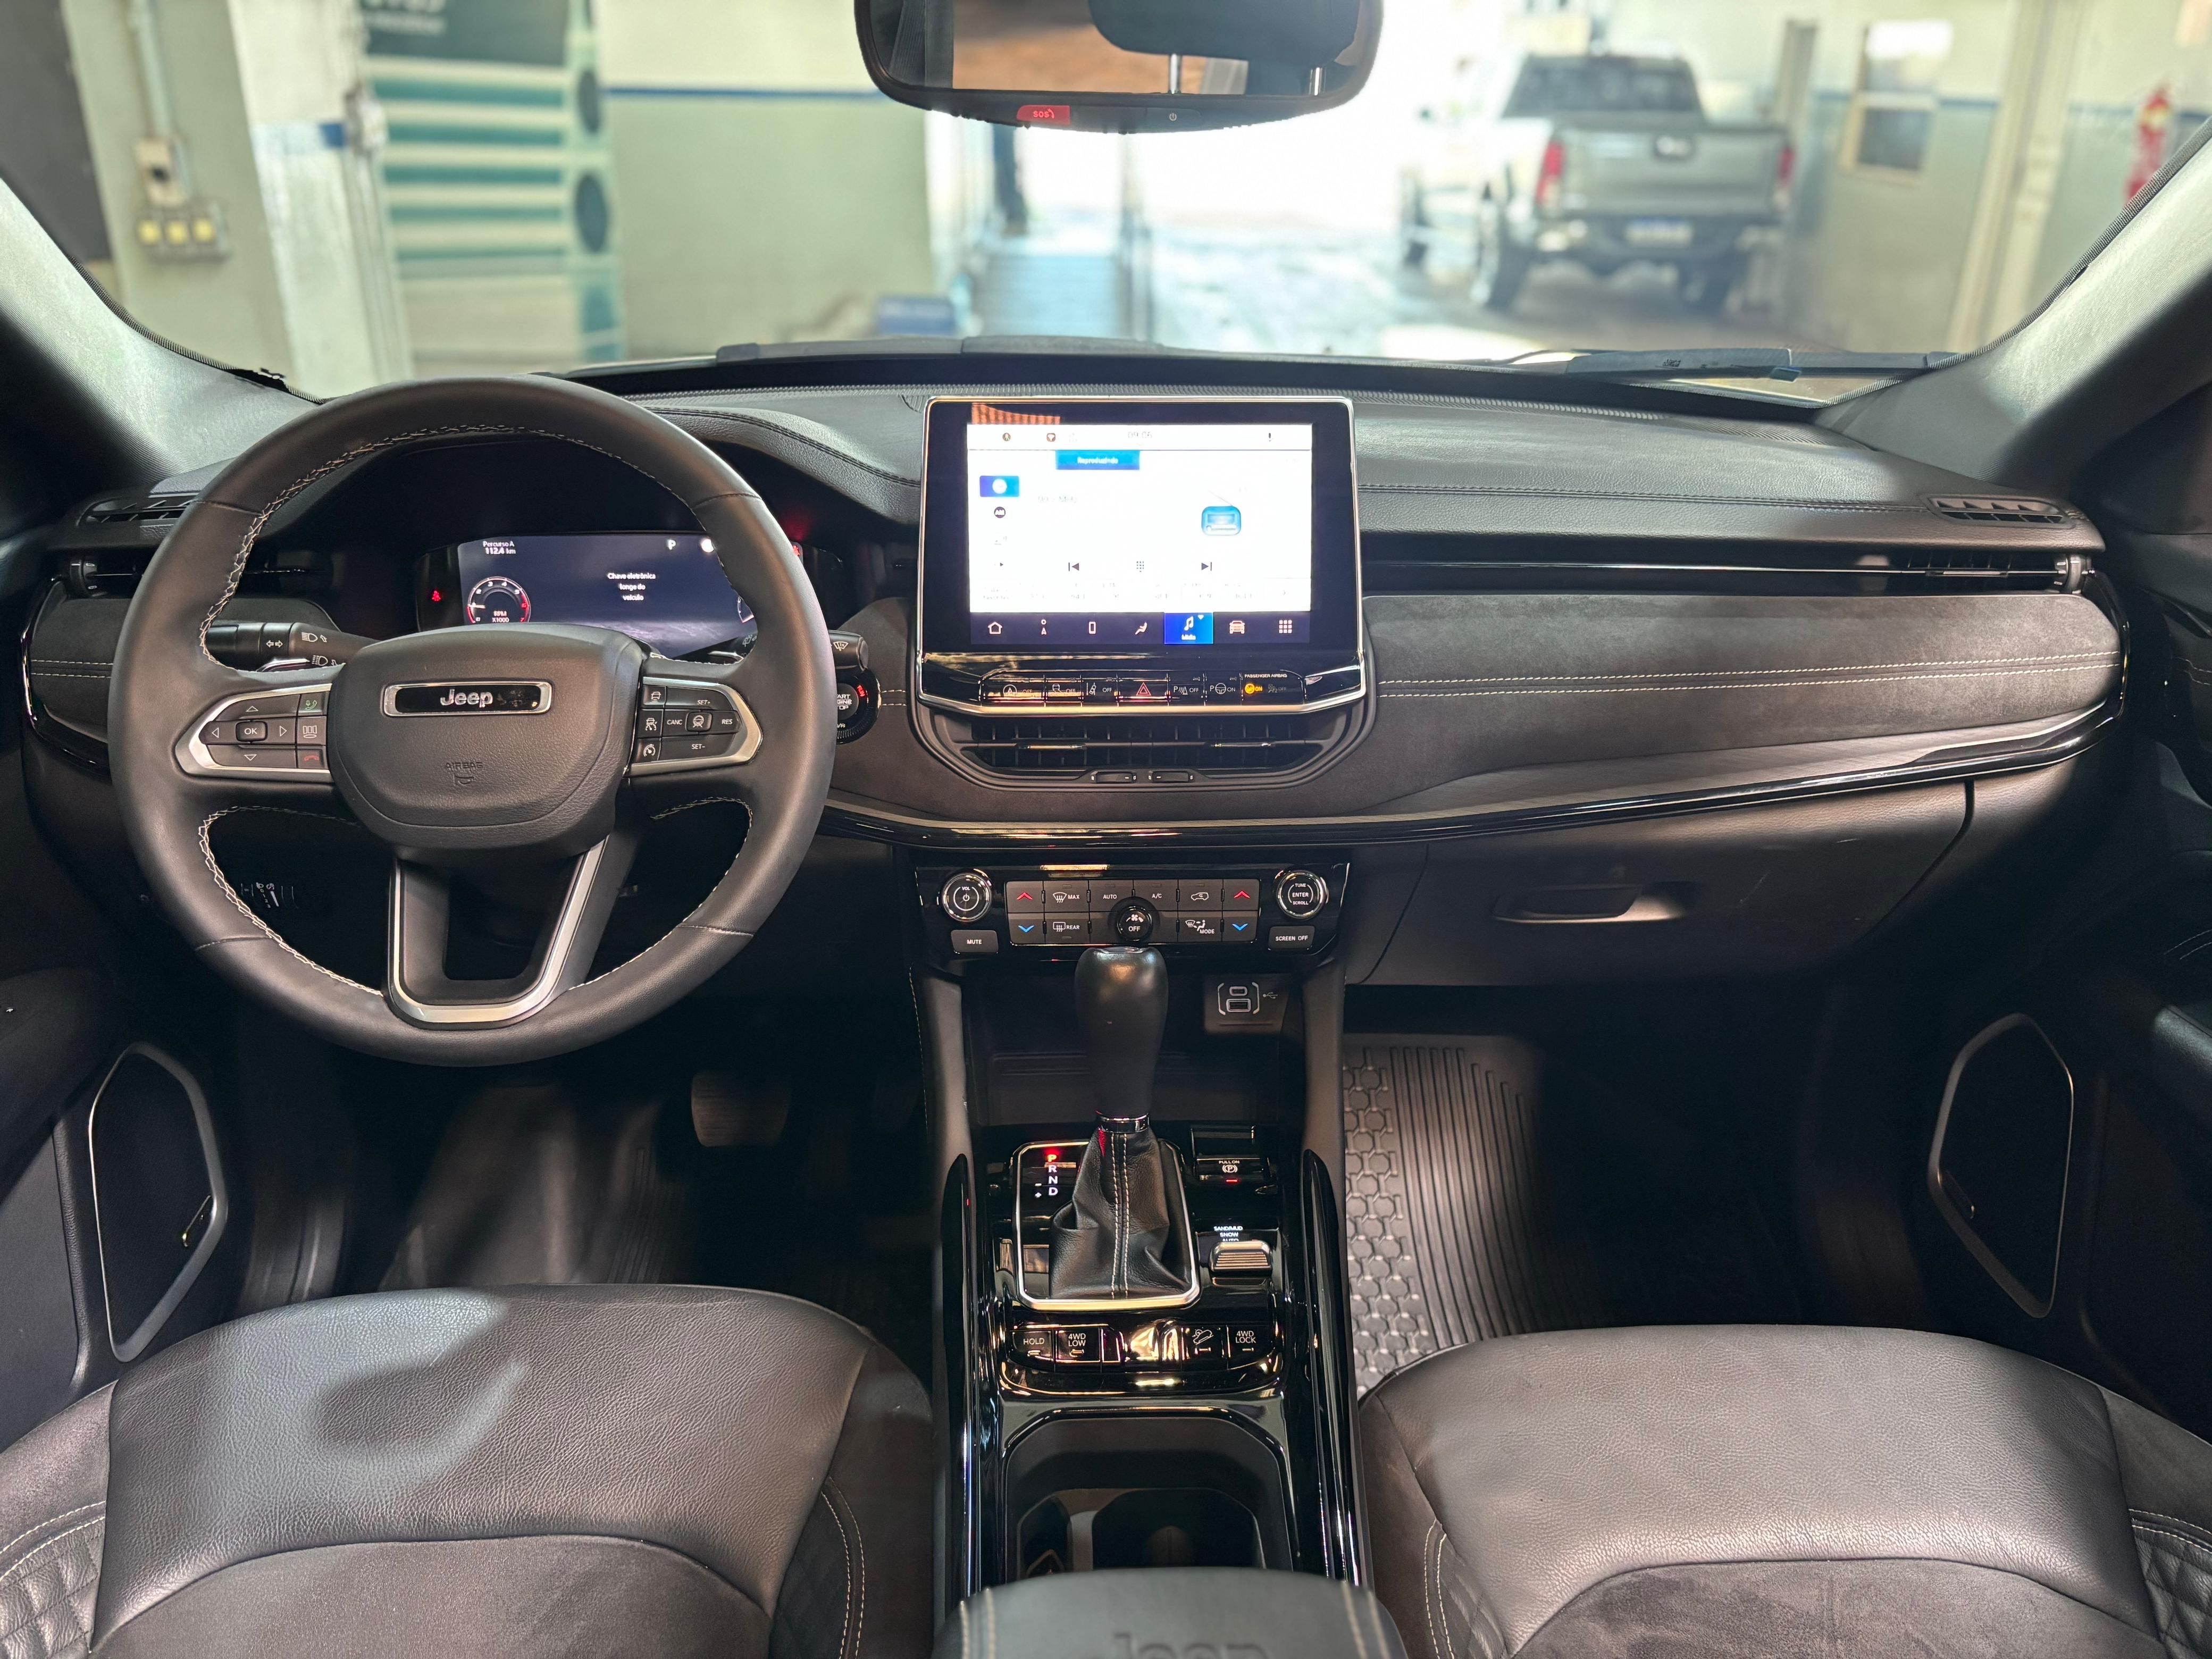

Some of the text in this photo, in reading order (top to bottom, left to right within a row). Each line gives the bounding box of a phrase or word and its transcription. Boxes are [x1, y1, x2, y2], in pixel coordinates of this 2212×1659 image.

[667, 539, 676, 550] P
[619, 583, 637, 591] longe
[440, 689, 493, 708] Jeep
[1048, 1154, 1057, 1163] P
[1048, 1164, 1057, 1173] R
[1048, 1176, 1058, 1184] N
[1048, 1187, 1058, 1196] D
